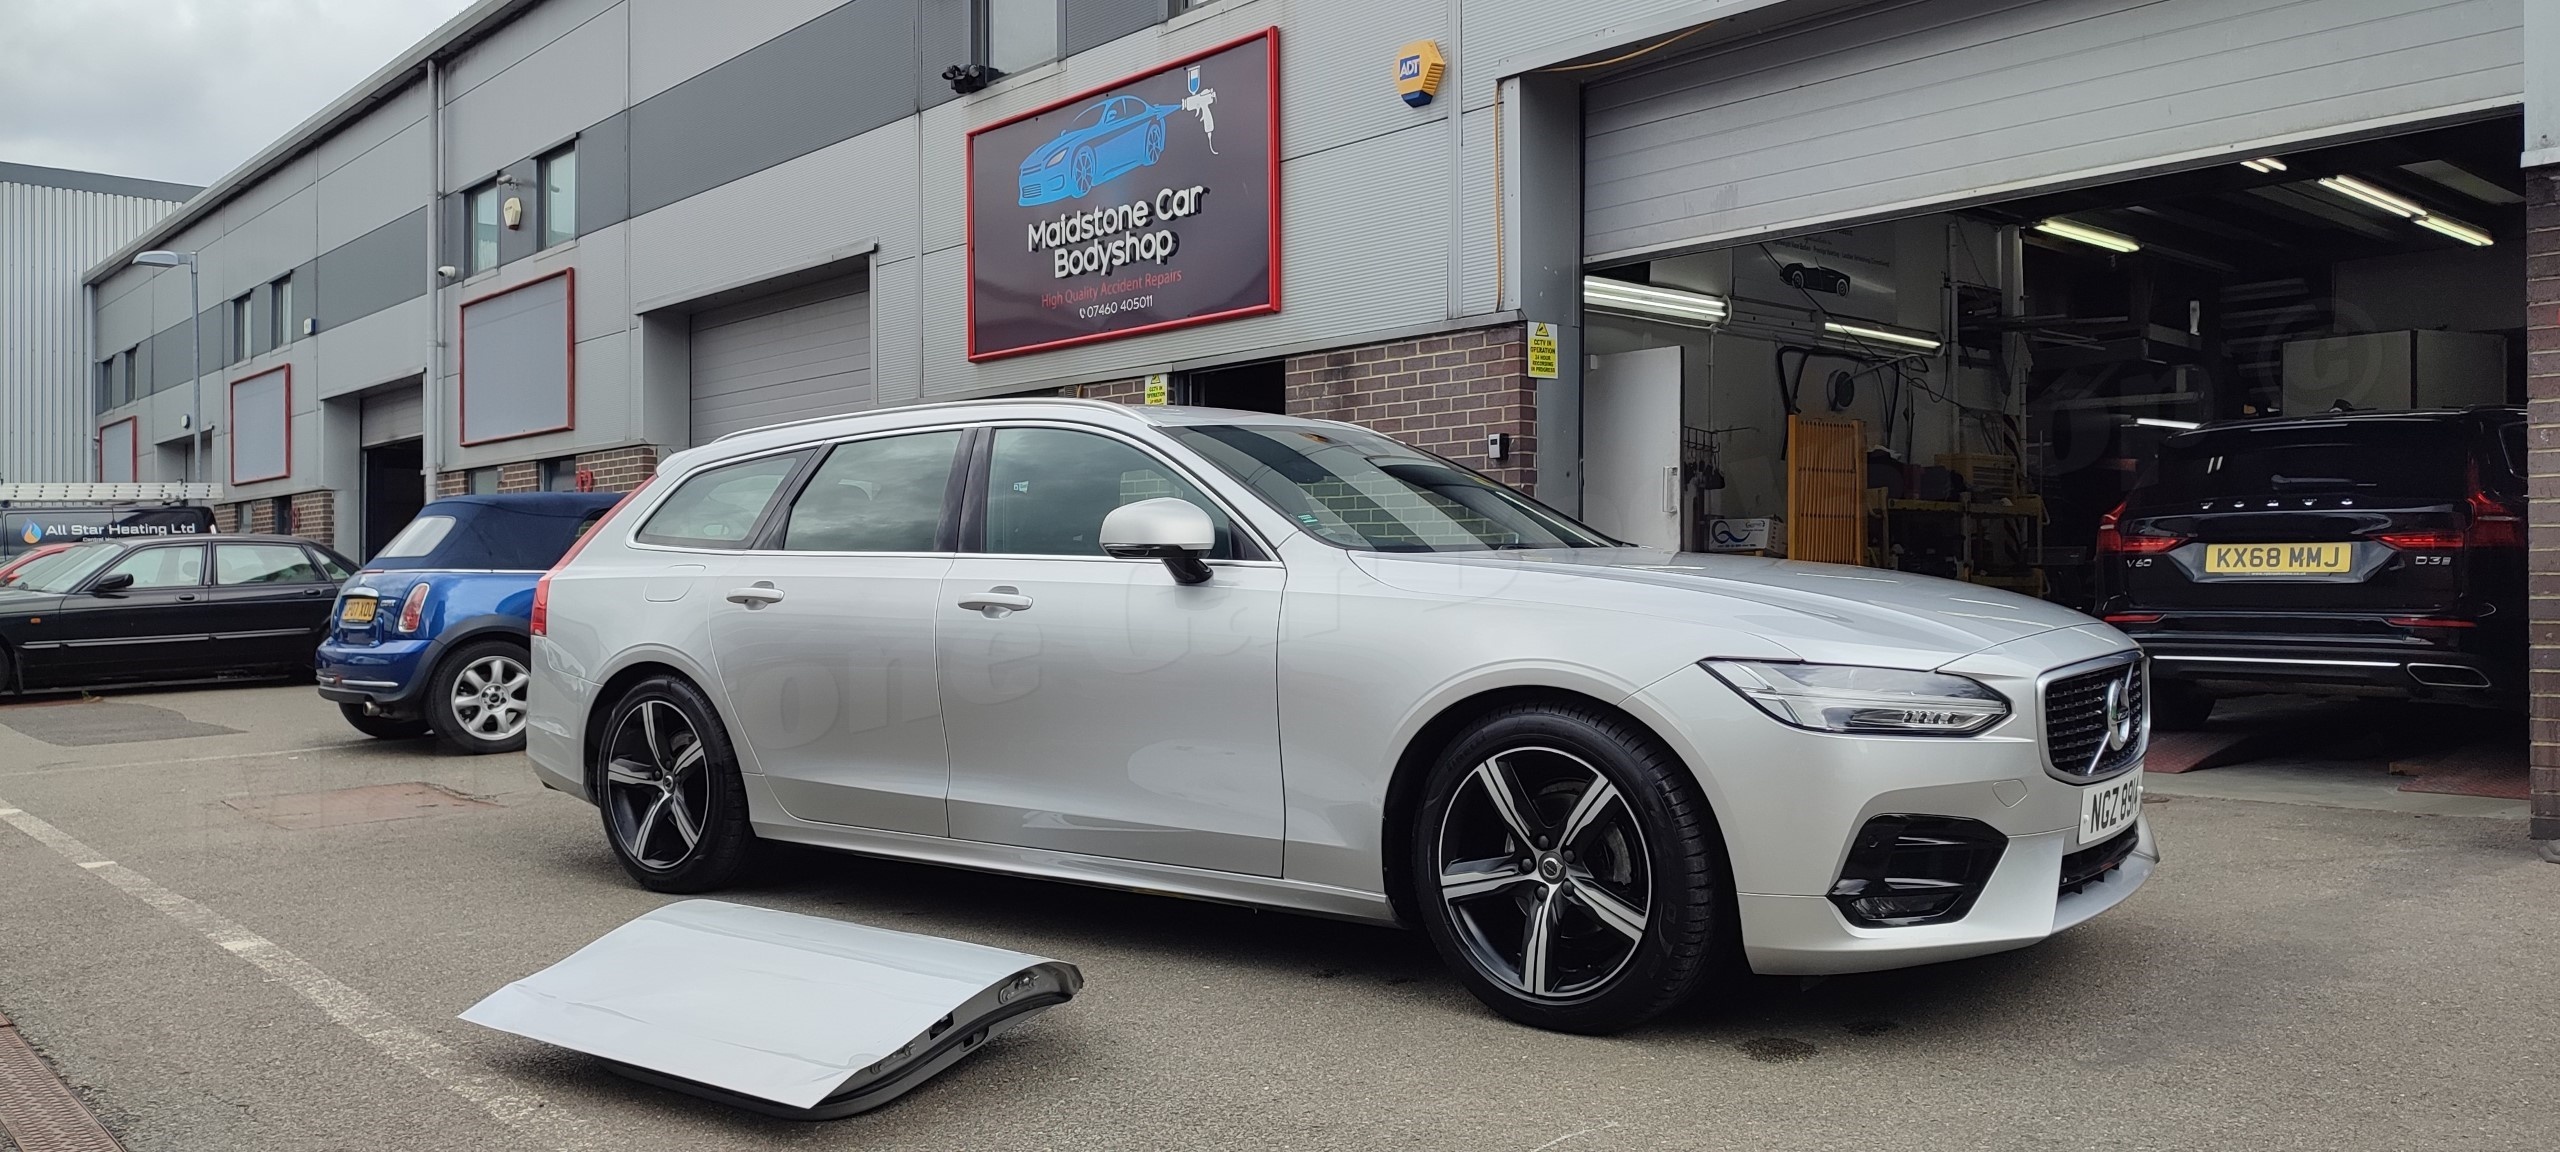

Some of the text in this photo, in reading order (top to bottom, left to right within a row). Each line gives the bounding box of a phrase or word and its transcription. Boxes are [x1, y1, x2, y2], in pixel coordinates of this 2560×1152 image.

[1400, 58, 1420, 78] ADT
[1028, 186, 1205, 252] Maidstone Car
[1054, 229, 1173, 278] Bodyshop
[1041, 270, 1182, 309] High Quality Accident Repairs
[1086, 294, 1153, 318] 07460 405011
[45, 522, 196, 536] All Star Heating Ltd
[2126, 559, 2152, 568] V60
[2216, 547, 2340, 568] KX68 MMJ
[2090, 786, 2119, 834] NGZ
